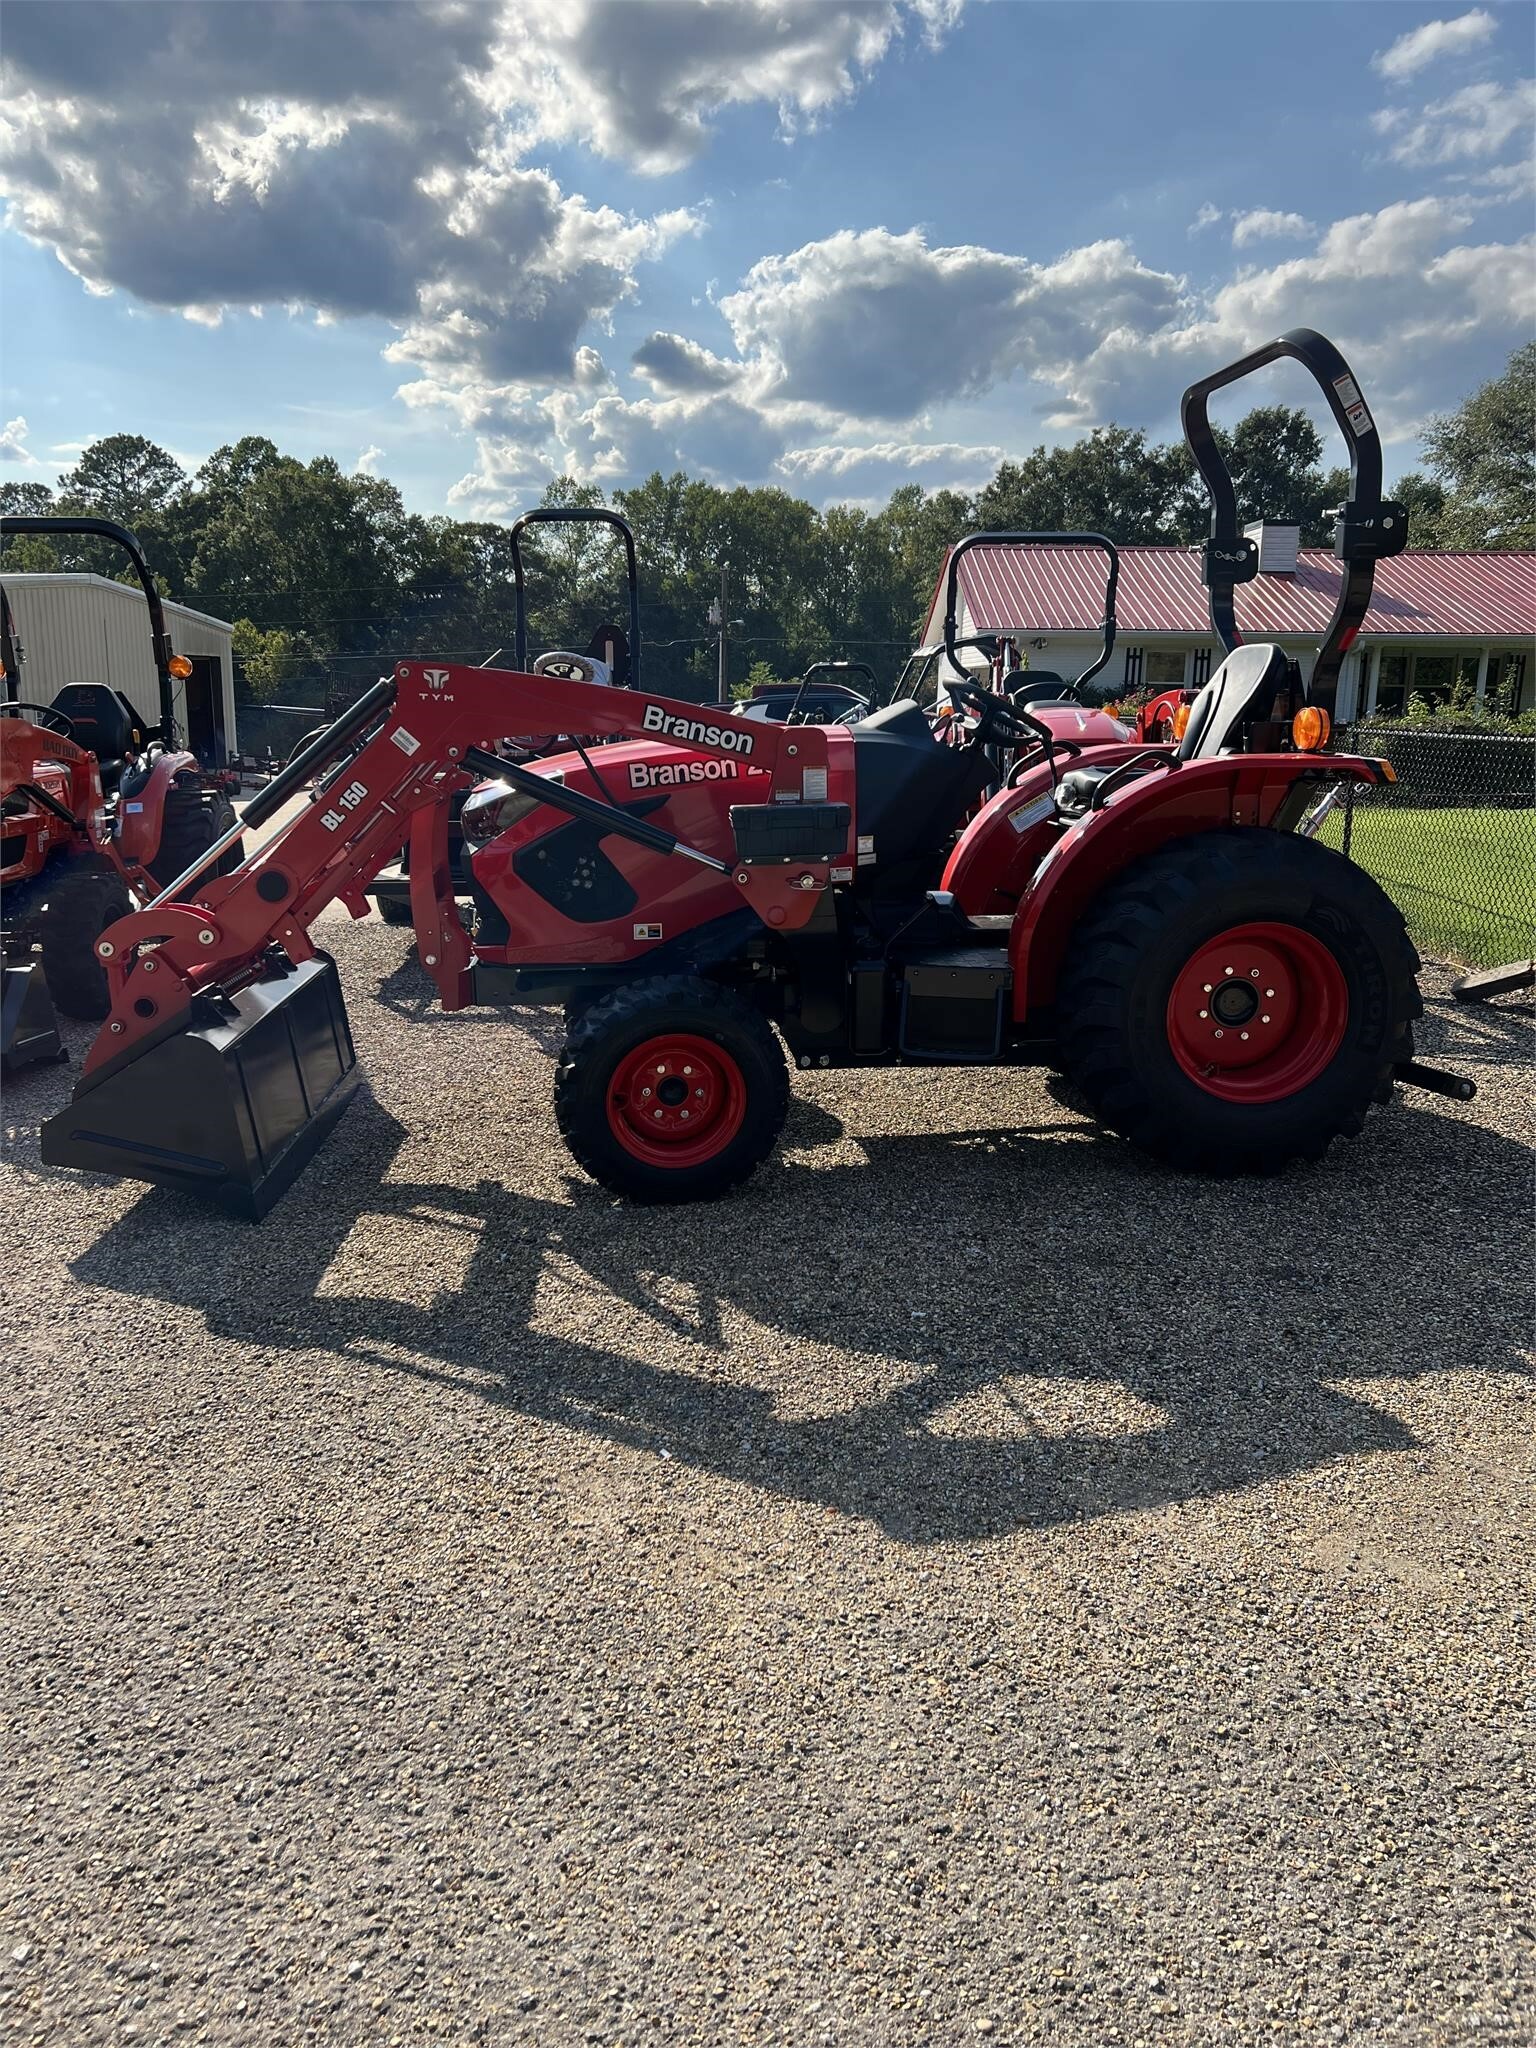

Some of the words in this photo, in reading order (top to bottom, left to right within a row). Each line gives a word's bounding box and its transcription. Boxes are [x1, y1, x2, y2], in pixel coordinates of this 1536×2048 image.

[418, 692, 454, 702] TYM
[642, 703, 754, 755] Branson
[628, 758, 738, 789] Branson
[319, 808, 346, 832] BL
[338, 780, 369, 811] 150
